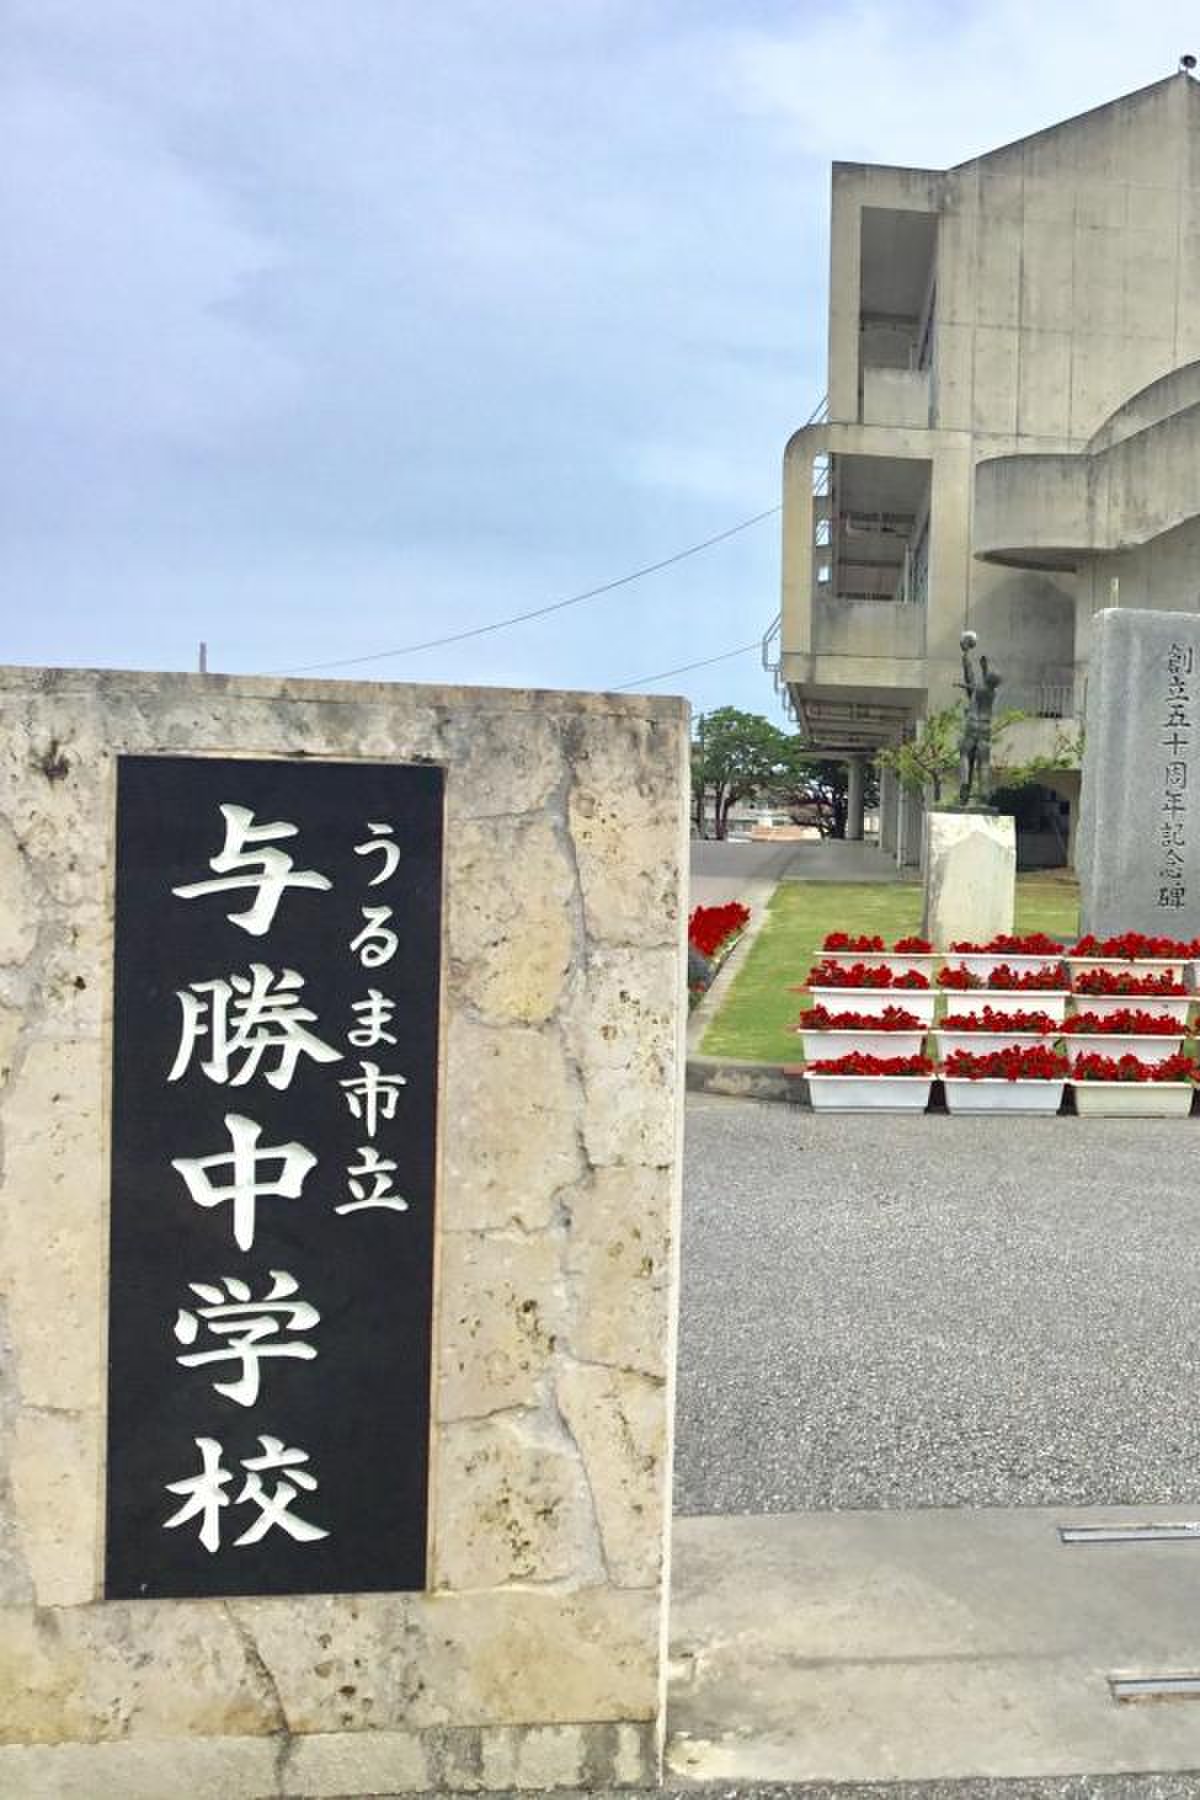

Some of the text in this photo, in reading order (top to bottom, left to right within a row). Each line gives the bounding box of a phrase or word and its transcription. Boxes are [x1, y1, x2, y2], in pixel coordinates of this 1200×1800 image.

[162, 803, 344, 1553] 与勝中学校
[335, 822, 409, 1216] うるま市立
